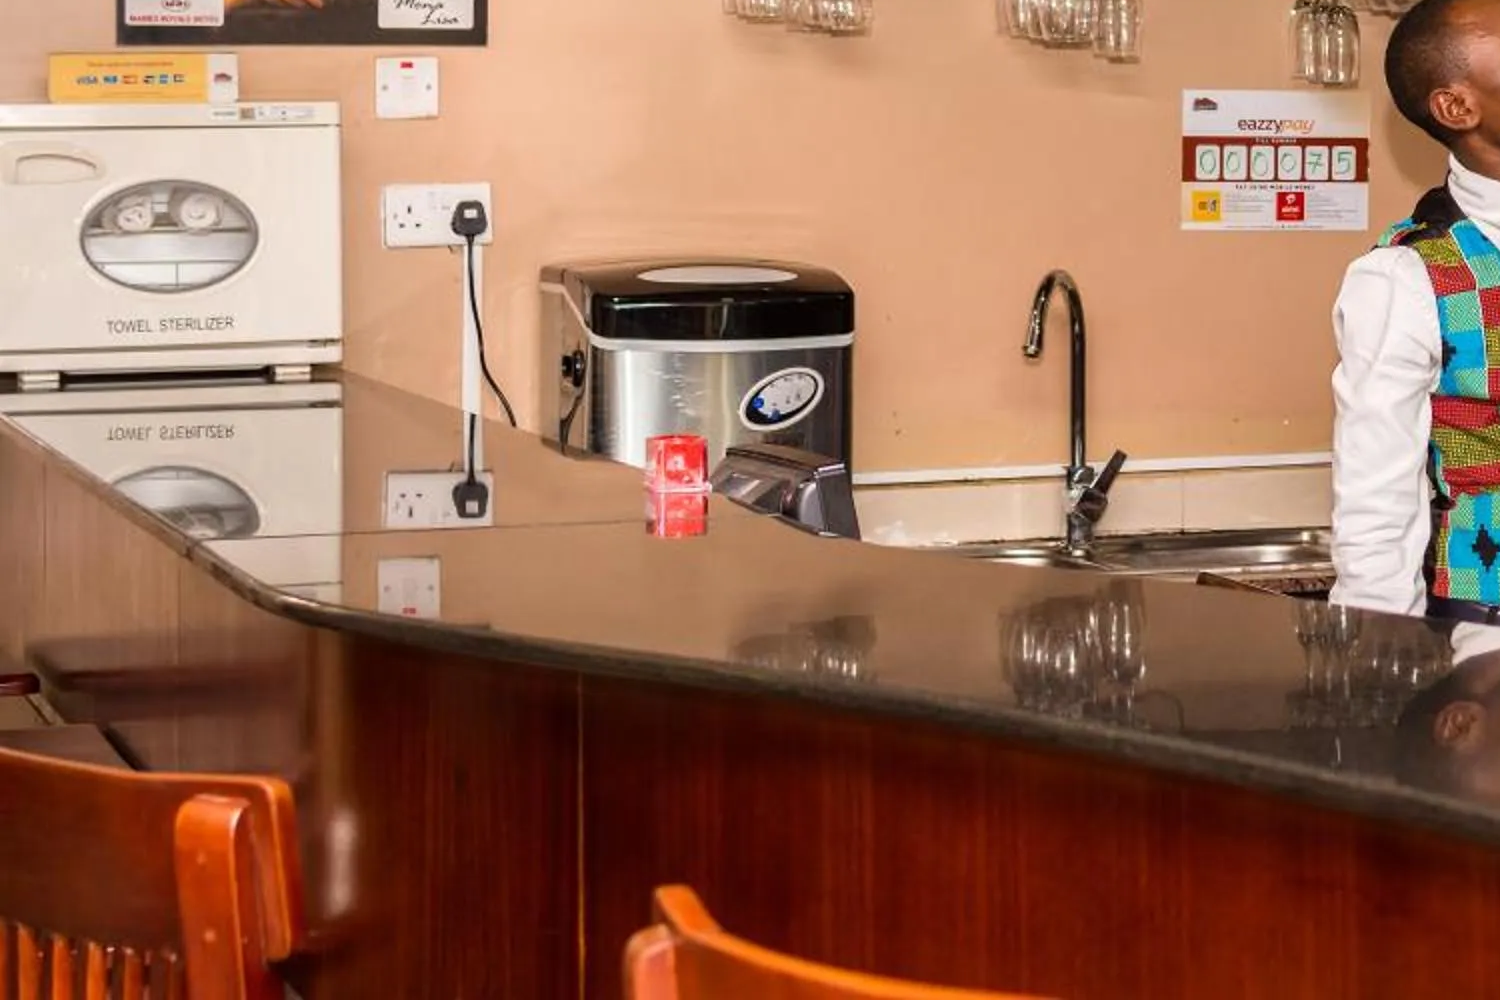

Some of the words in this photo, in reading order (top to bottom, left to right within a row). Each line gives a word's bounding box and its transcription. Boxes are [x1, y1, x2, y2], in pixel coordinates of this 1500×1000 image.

[1237, 119, 1316, 135] eazzypay
[107, 318, 152, 334] TOWEL
[159, 316, 235, 332] STERILIZER
